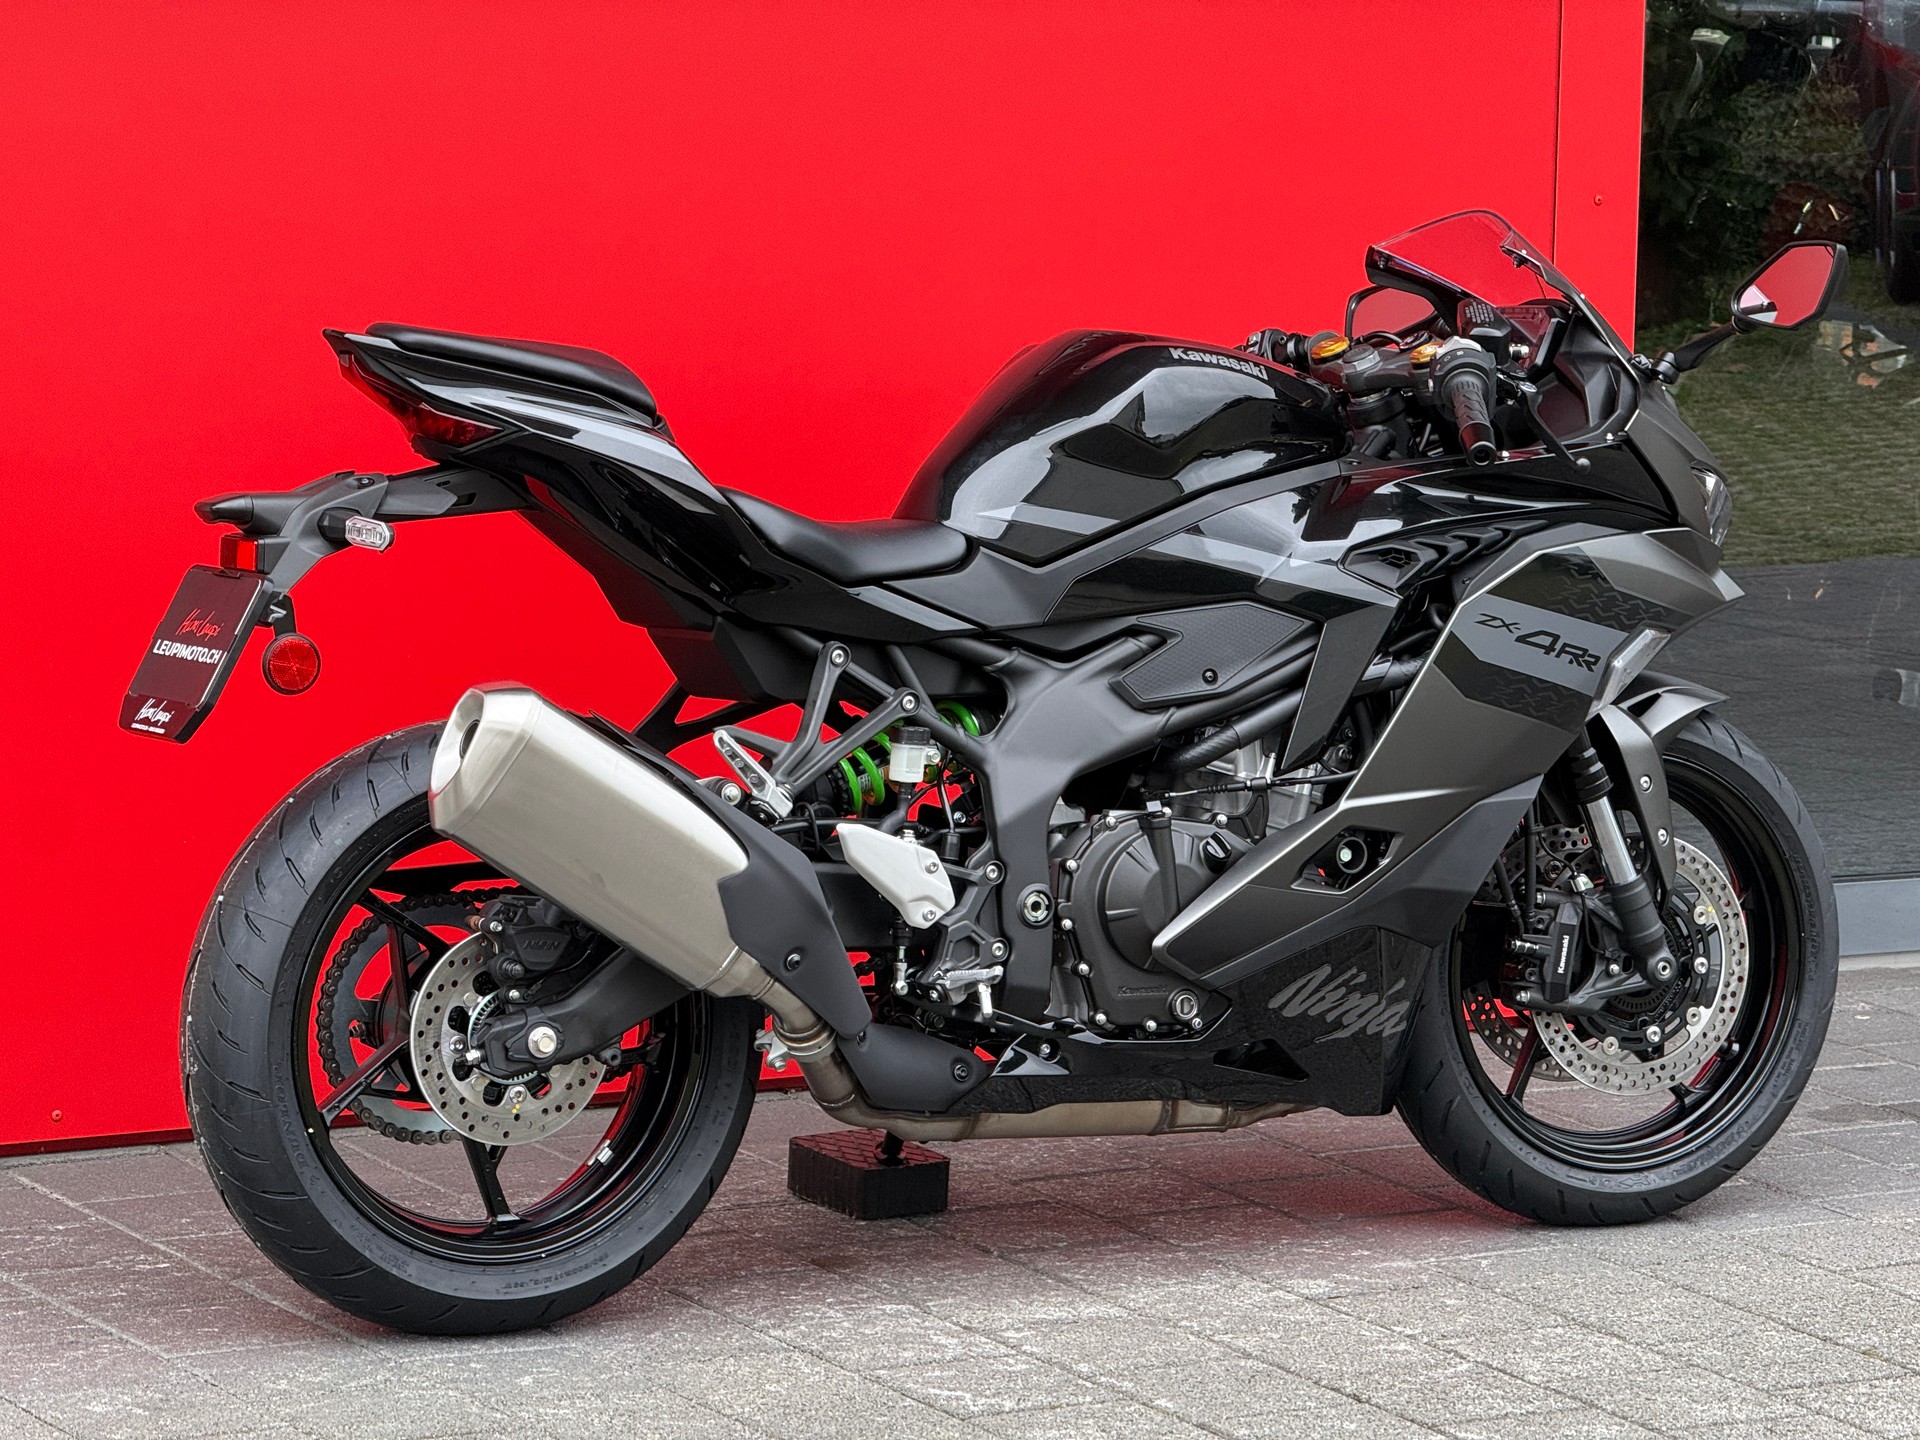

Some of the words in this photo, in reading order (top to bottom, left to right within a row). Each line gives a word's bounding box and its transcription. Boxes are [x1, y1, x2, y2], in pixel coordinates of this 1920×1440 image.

[1168, 347, 1269, 381] Kawasaki
[153, 639, 222, 664] LEUPIMOTO.CH
[1557, 934, 1570, 974] Kawasaki
[1267, 964, 1410, 1043] Ninja
